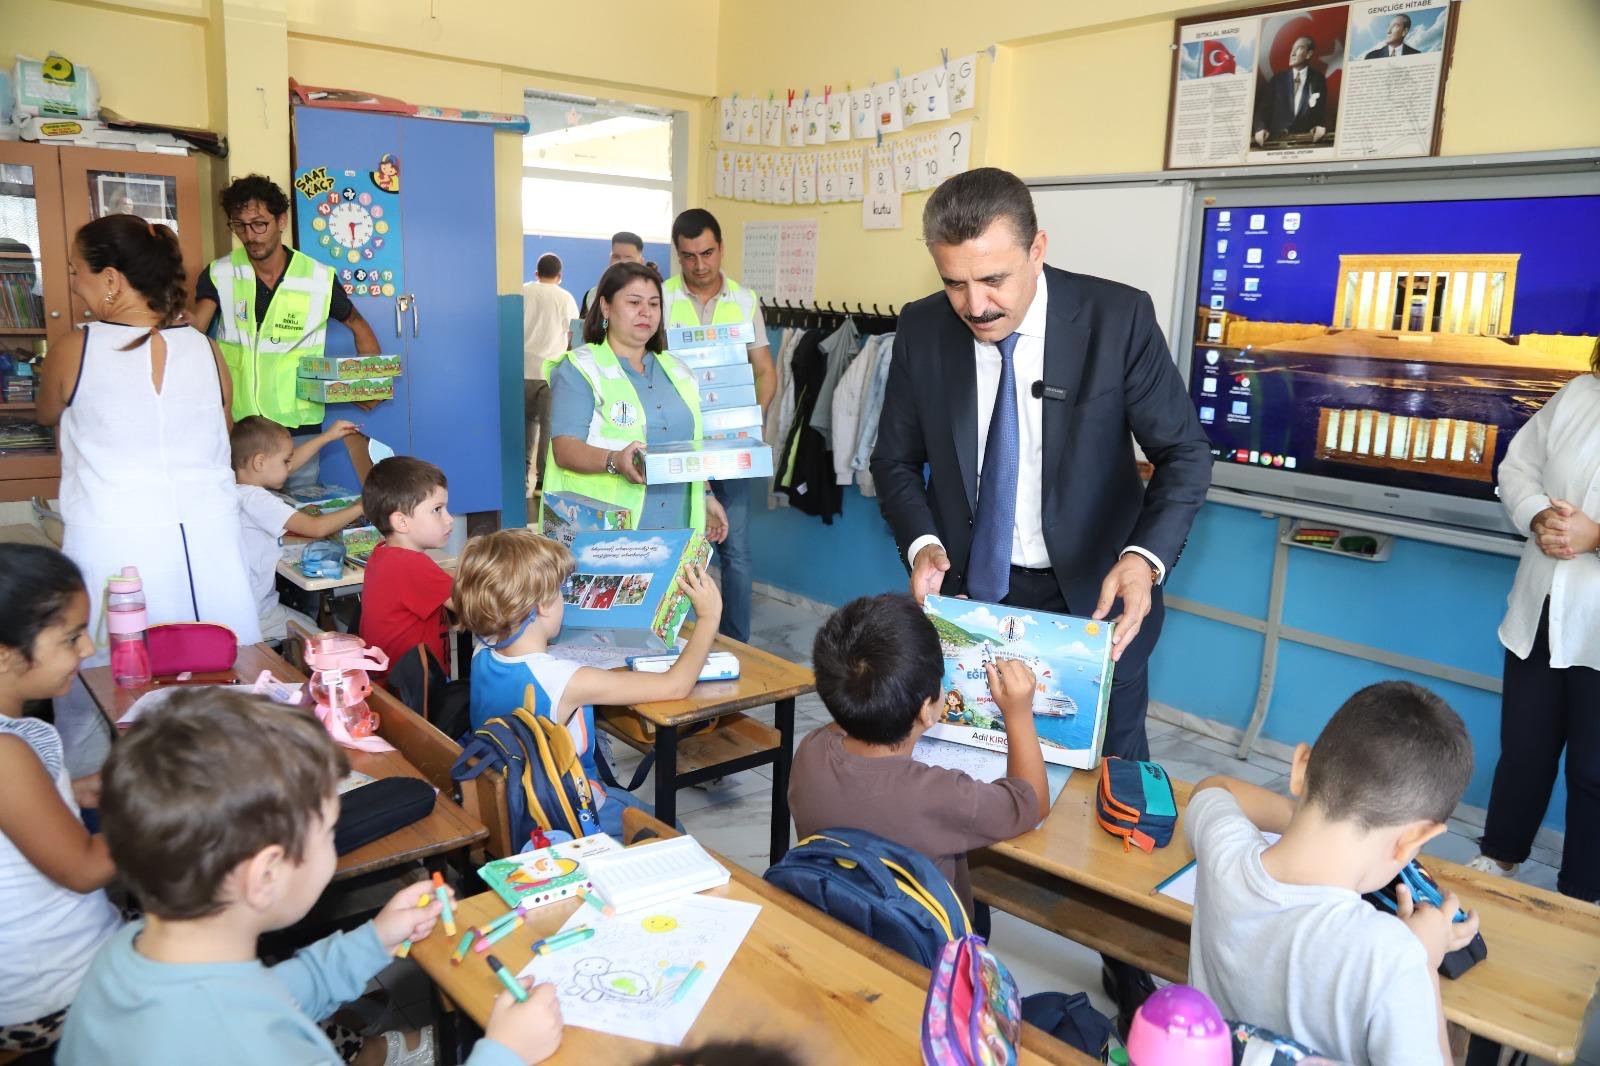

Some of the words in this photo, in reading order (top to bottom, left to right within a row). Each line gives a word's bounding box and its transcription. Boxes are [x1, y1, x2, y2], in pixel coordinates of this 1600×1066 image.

[934, 73, 946, 88] V
[888, 86, 895, 102] P
[838, 98, 846, 112] Y
[864, 93, 872, 109] B
[950, 132, 962, 163] ?
[904, 166, 911, 180] 9
[926, 160, 938, 175] 10
[296, 168, 326, 190] SAAT
[742, 179, 746, 192] 2
[760, 179, 766, 192] 3
[826, 179, 832, 192] 6
[849, 177, 853, 190] 7
[878, 172, 884, 186] 8
[779, 180, 785, 192] 4
[802, 180, 808, 194] 5
[330, 193, 339, 204] 11
[319, 203, 331, 215] 10
[873, 202, 892, 215] kutu
[364, 248, 373, 259] 5
[972, 732, 988, 742] Adil
